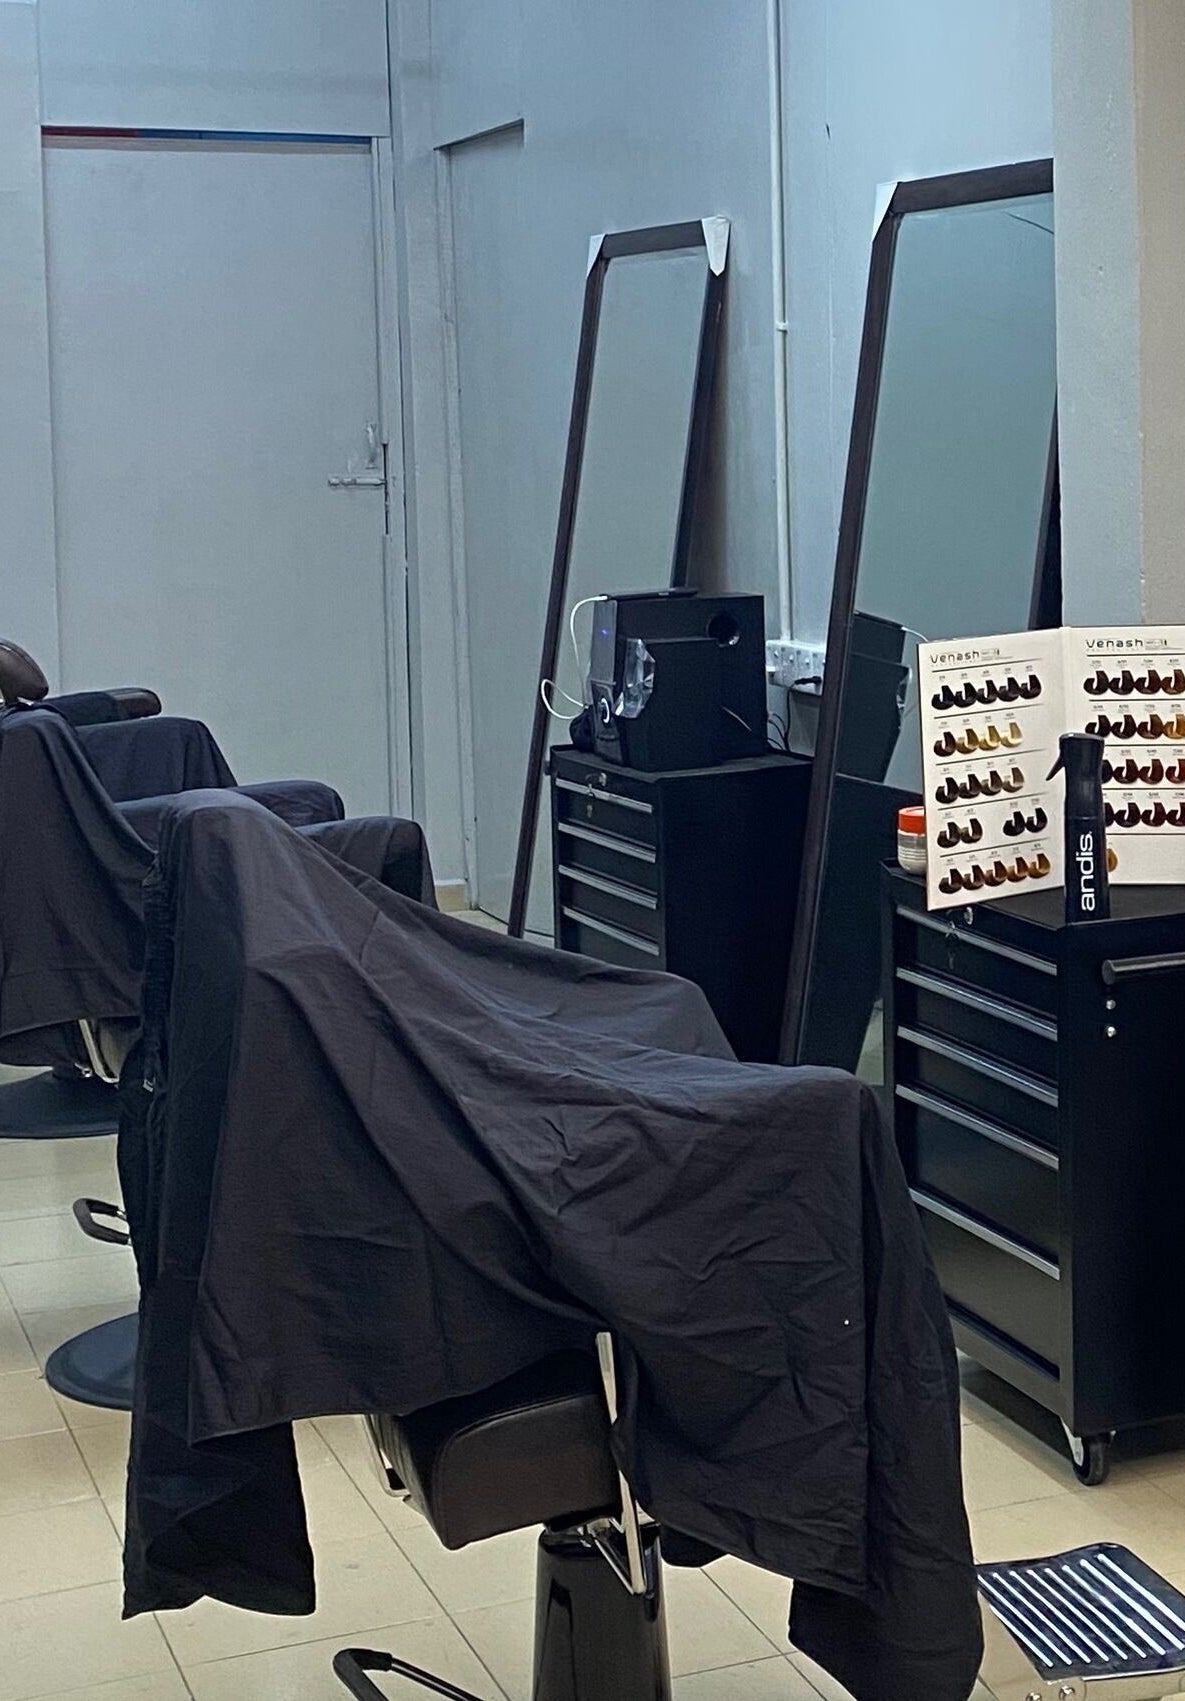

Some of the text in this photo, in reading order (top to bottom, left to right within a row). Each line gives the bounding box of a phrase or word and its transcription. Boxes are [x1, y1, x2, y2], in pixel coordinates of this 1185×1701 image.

[1085, 638, 1144, 649] Venash
[930, 650, 980, 664] Venash
[1075, 832, 1096, 912] andis
